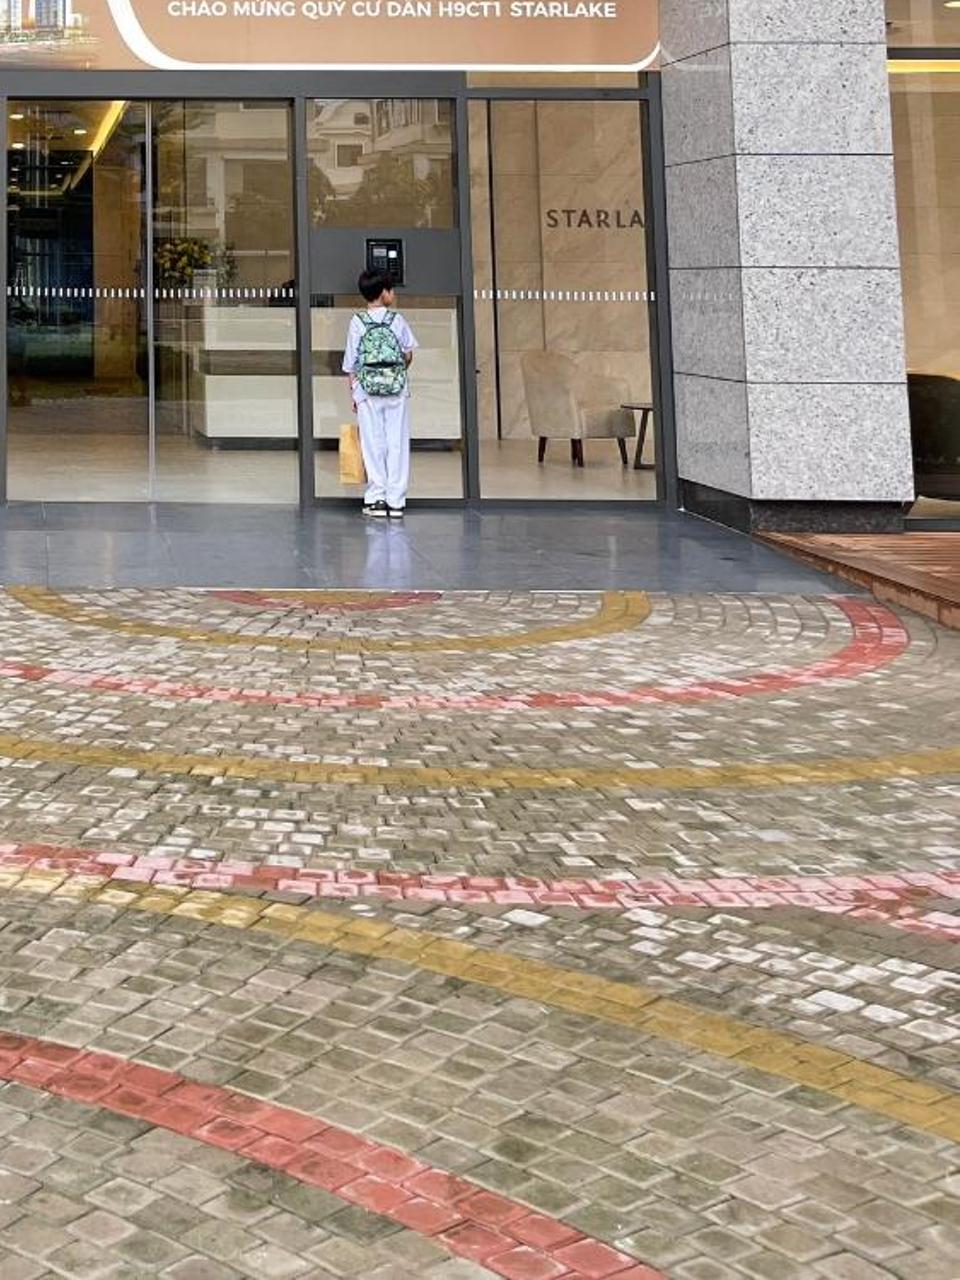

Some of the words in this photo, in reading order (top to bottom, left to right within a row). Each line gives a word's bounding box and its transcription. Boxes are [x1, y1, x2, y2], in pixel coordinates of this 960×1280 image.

[351, 0, 381, 17] CƯ
[438, 1, 501, 18] H9CT1
[510, 1, 617, 18] STARLAKE
